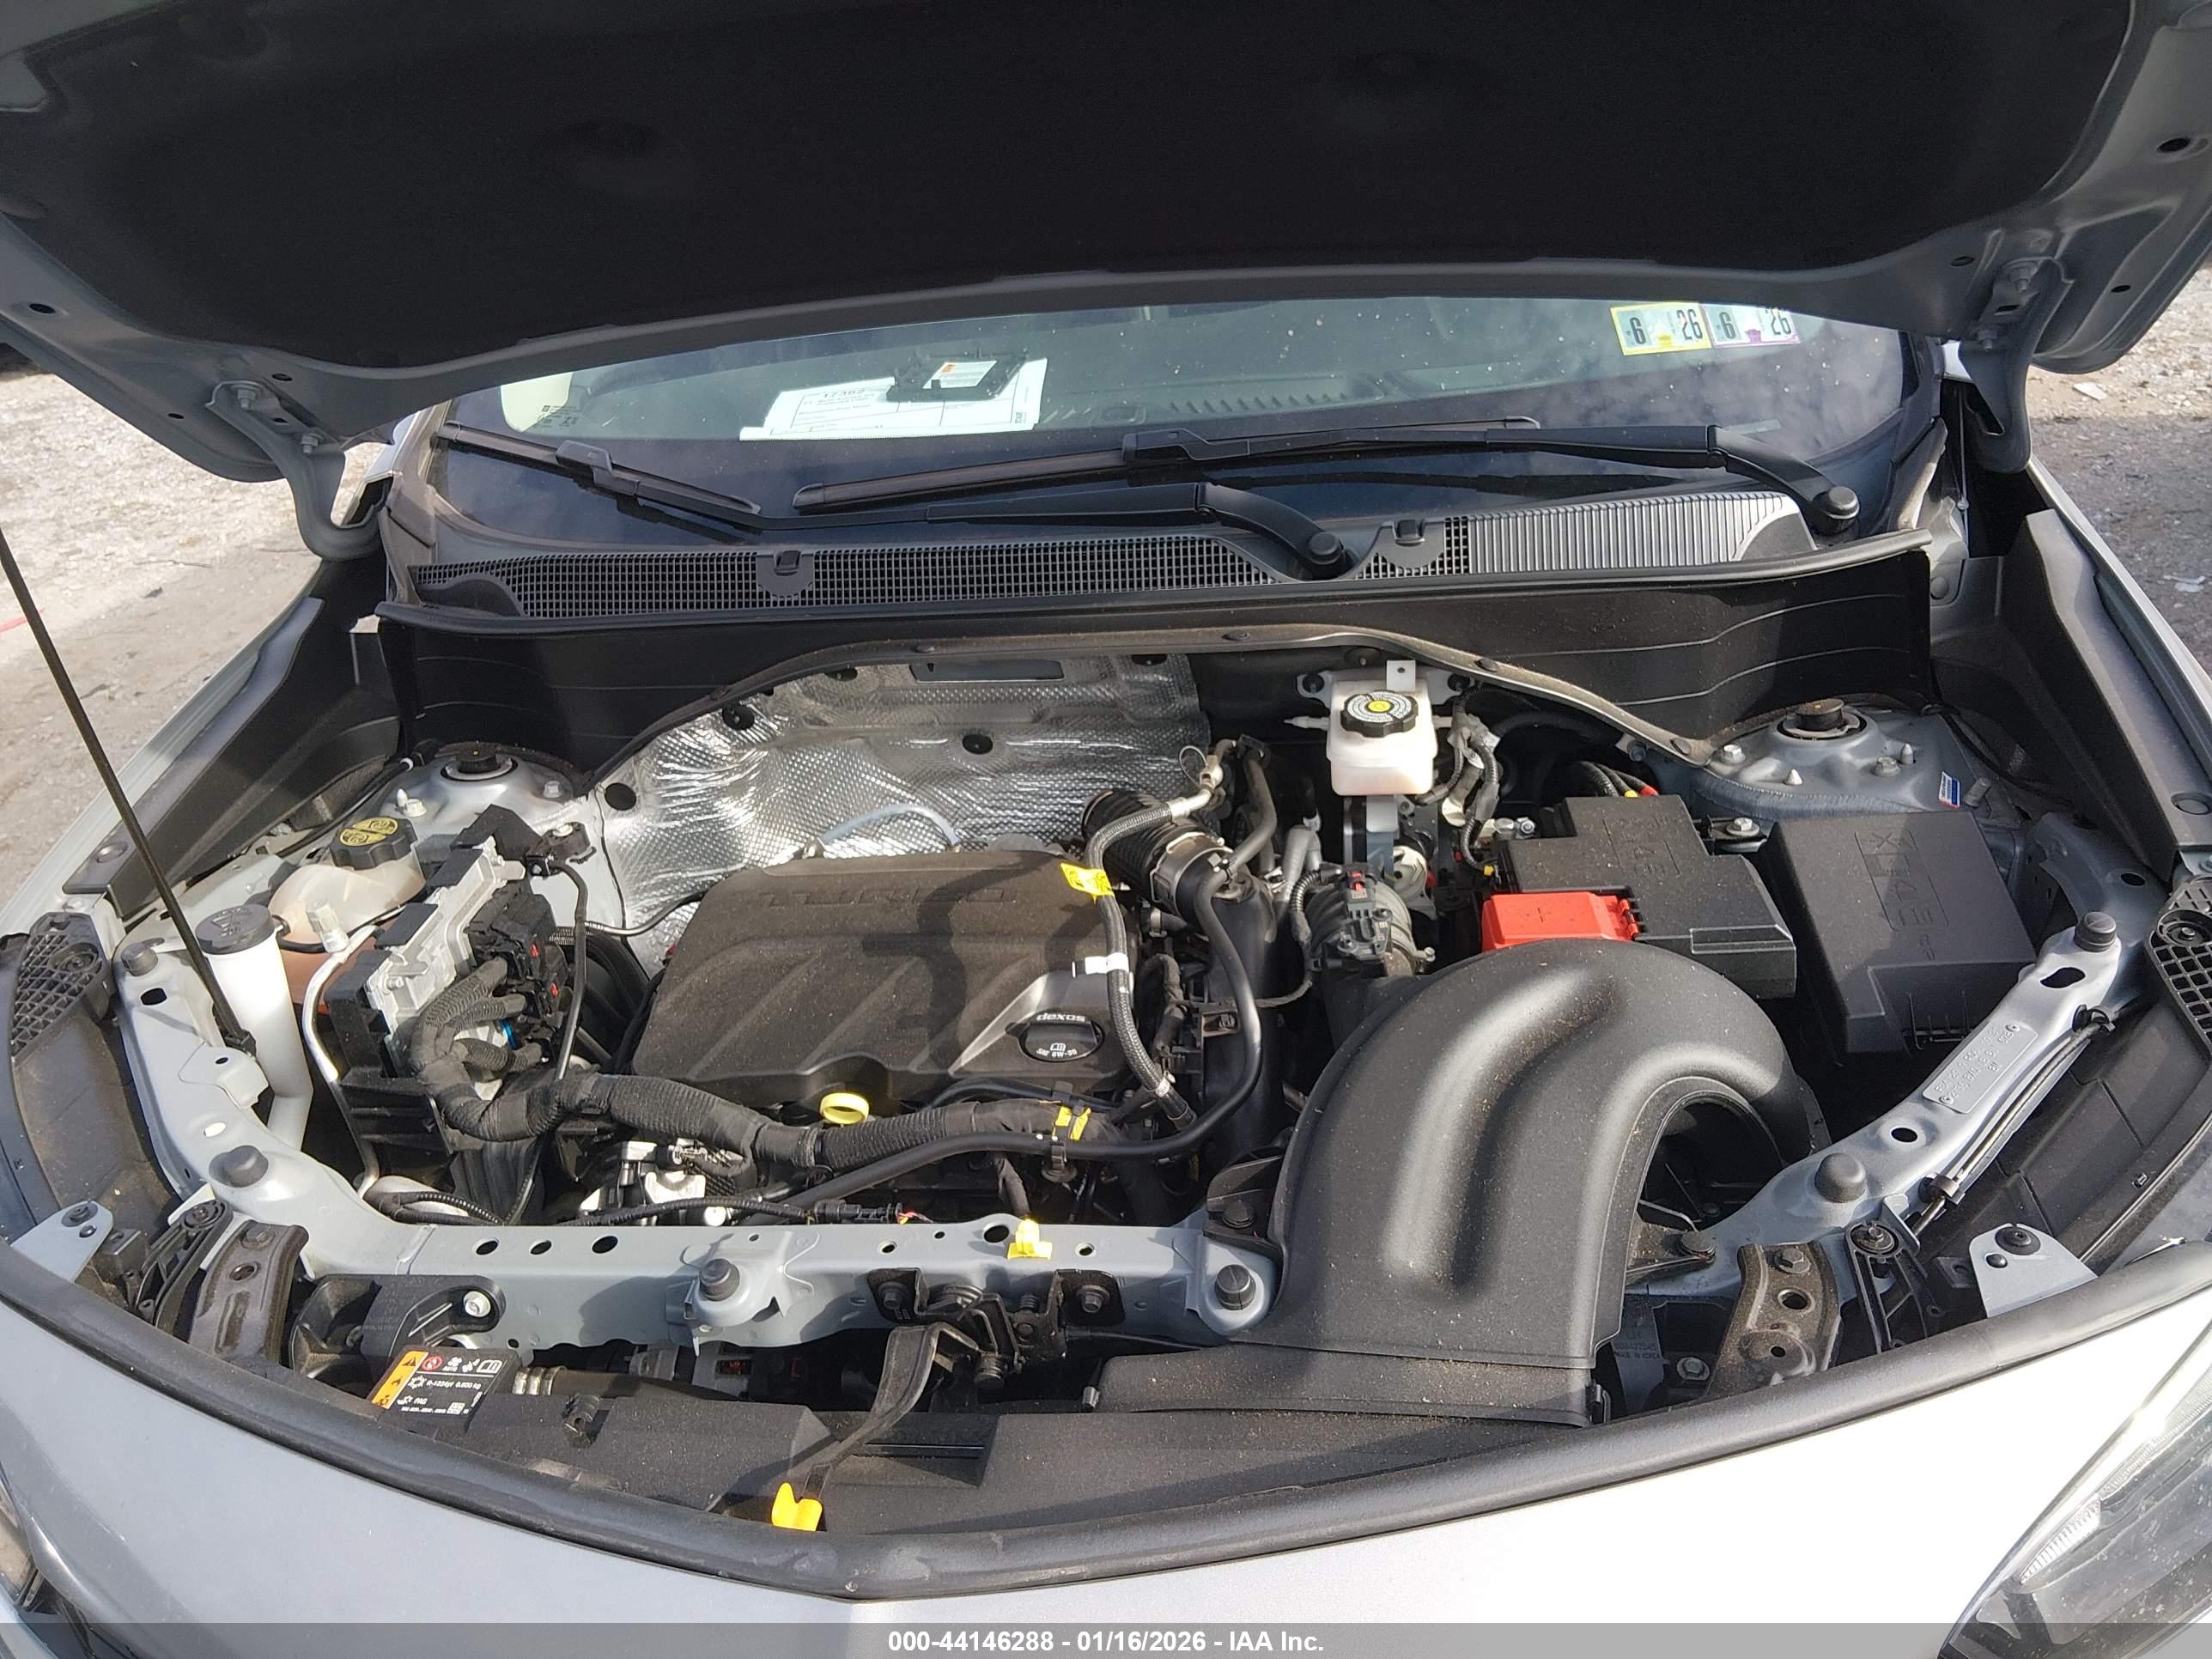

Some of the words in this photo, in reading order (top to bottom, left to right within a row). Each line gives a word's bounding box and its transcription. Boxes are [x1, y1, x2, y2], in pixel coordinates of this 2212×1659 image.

[1630, 317, 1646, 345] 6
[1676, 309, 1704, 340] 26
[1719, 312, 1736, 339] 6
[1036, 1013, 1086, 1023] dexos
